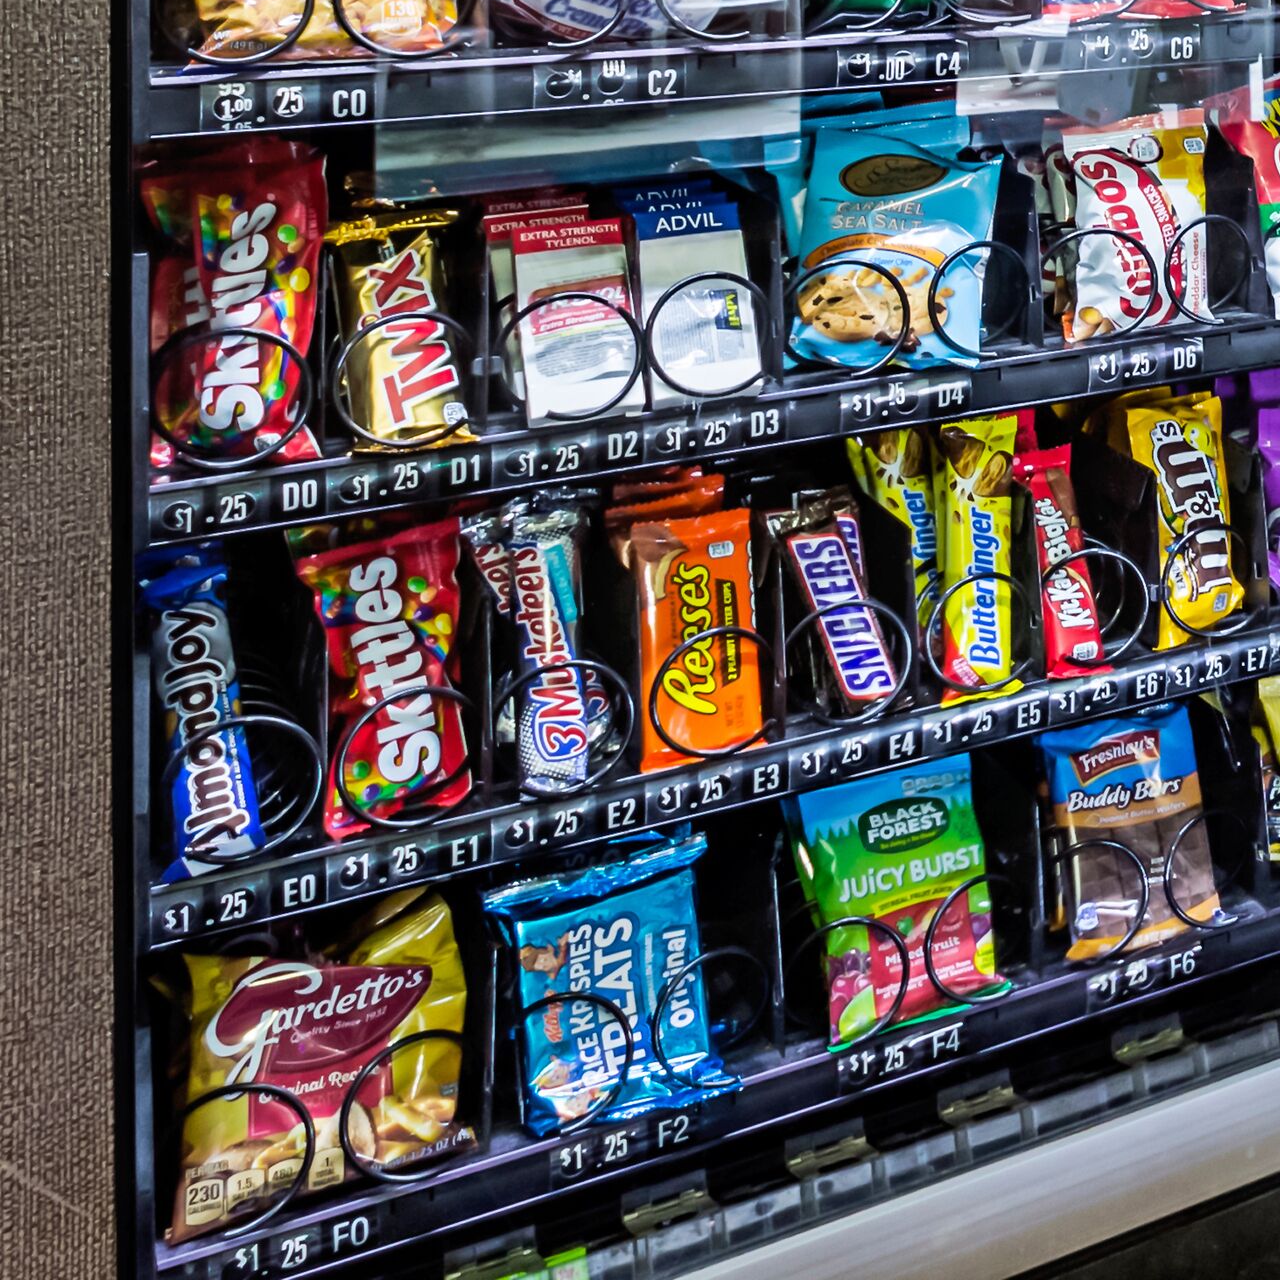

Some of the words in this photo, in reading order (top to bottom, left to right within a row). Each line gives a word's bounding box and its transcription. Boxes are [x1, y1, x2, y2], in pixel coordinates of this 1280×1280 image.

[388, 0, 416, 16] 130
[1170, 36, 1194, 60] C6
[935, 52, 962, 76] C4
[647, 69, 677, 96] C2
[836, 199, 925, 217] CARAMEL
[1144, 183, 1171, 223] SNACKS
[490, 219, 526, 233] EXTRA
[528, 214, 586, 228] STRENGTH
[519, 229, 558, 243] EXTRA
[560, 223, 619, 238] STRENGTH
[655, 211, 723, 234] ADVIL
[831, 214, 867, 230] SEA
[874, 213, 923, 231] SALT
[545, 235, 597, 249] TYLENOL
[1191, 231, 1201, 271] Cheese
[1173, 347, 1197, 371] D6
[750, 409, 779, 437] D3
[607, 430, 639, 460] D2
[451, 454, 481, 485] D1
[723, 583, 733, 605] CUPS
[968, 504, 1002, 670] Butterfinger
[794, 537, 893, 694] SNICKERS
[513, 547, 585, 720] Musketeers
[662, 563, 718, 715] Reese's
[164, 609, 227, 688] Joy
[725, 639, 737, 673] PEANUT
[1247, 646, 1268, 672] E7
[348, 555, 442, 785] Skittles
[1136, 674, 1158, 699] E6
[1017, 705, 1041, 729] E5
[547, 726, 587, 756] 3
[889, 734, 915, 760] E4
[1079, 735, 1156, 773] Freshley's
[754, 763, 780, 793] E3
[1067, 786, 1131, 812] Buddy
[1135, 776, 1182, 802] Bars
[607, 799, 637, 830] E2
[868, 801, 938, 828] BLACK
[1098, 812, 1129, 824] Peanut
[1129, 807, 1156, 819] Butter
[1155, 800, 1187, 816] Wafers
[867, 811, 945, 844] FOREST
[451, 835, 479, 867] E1
[838, 863, 906, 904] JUICY
[909, 843, 982, 884] BURST
[1170, 952, 1195, 979] F6
[593, 917, 648, 1076] TREATS
[205, 962, 425, 1101] Gardetto's
[290, 1024, 331, 1044] Quality
[333, 1018, 362, 1030] Since
[932, 1031, 961, 1059] F4
[577, 1033, 604, 1088] RICE
[658, 1115, 689, 1148] F2
[188, 1183, 220, 1205] 230
